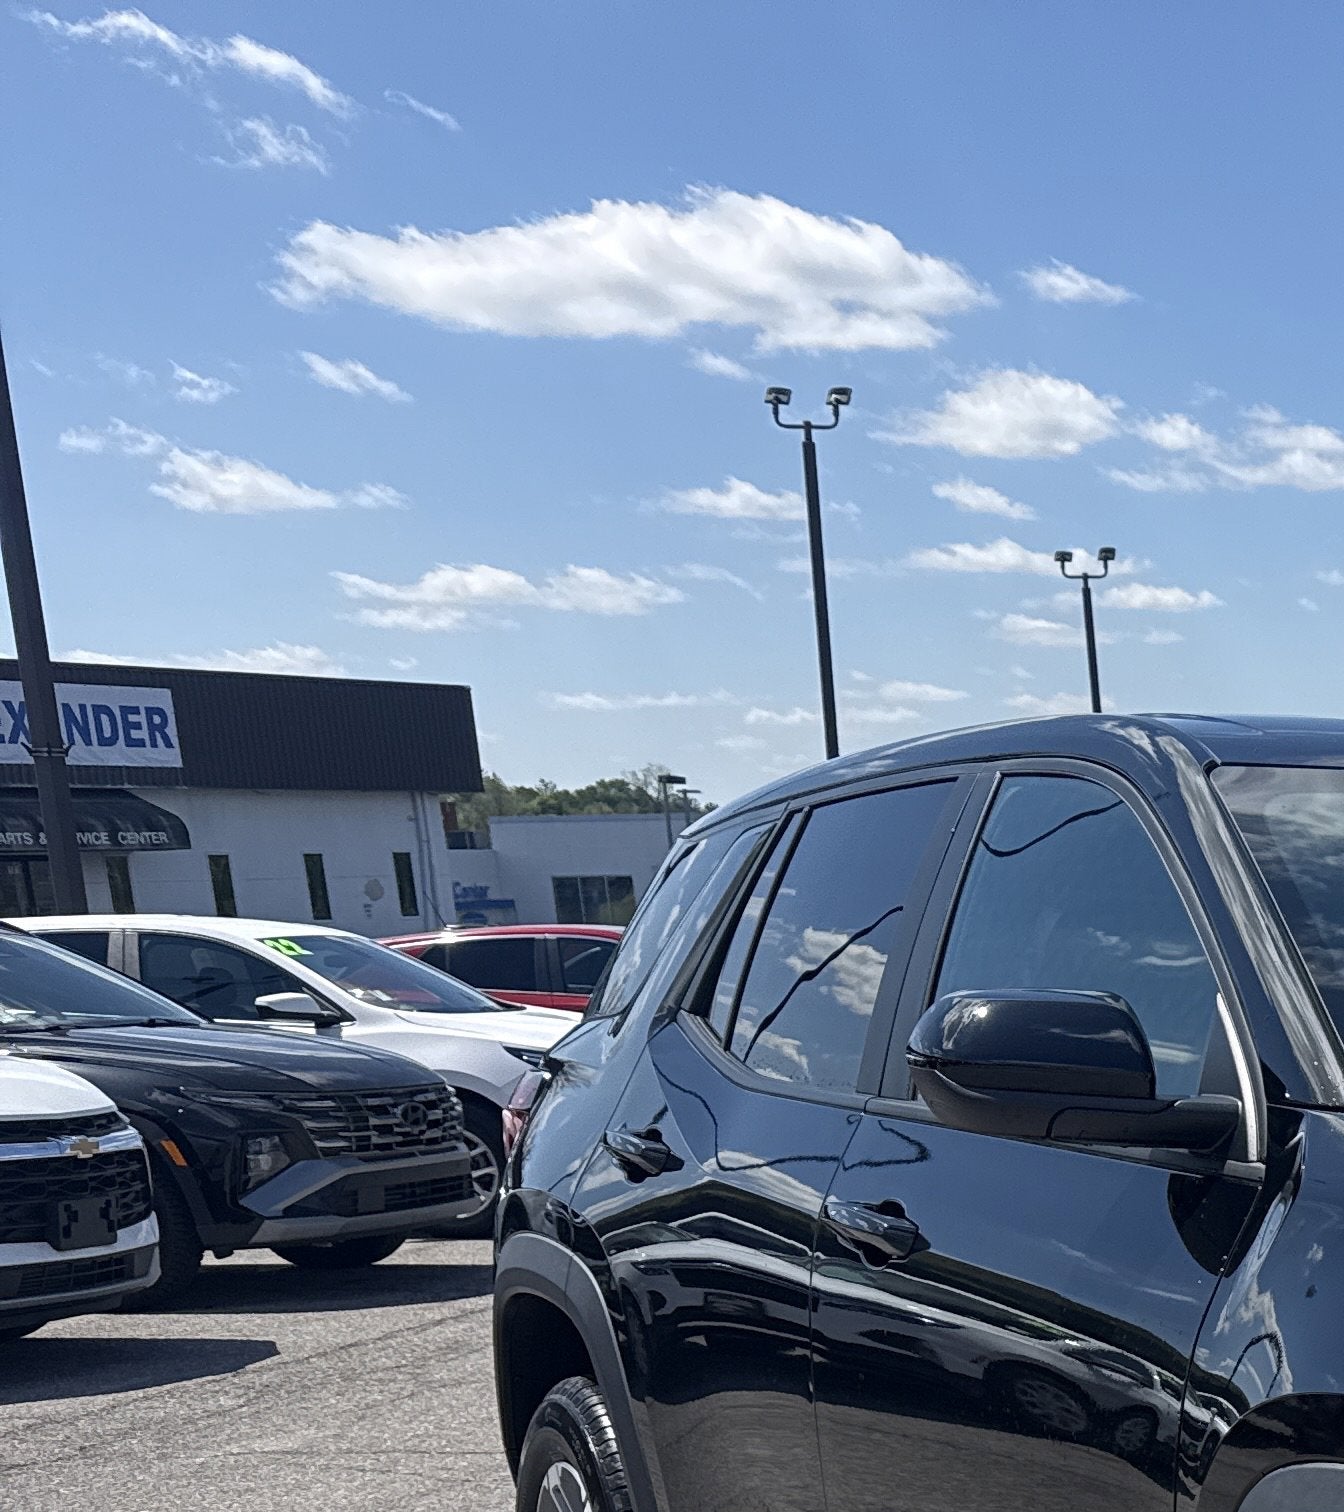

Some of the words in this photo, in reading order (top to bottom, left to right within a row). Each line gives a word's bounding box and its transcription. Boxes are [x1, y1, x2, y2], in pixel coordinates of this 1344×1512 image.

[0, 700, 175, 748] XNDER
[0, 832, 33, 845] ARTS
[76, 832, 111, 845] VICE
[117, 832, 169, 845] CENTER
